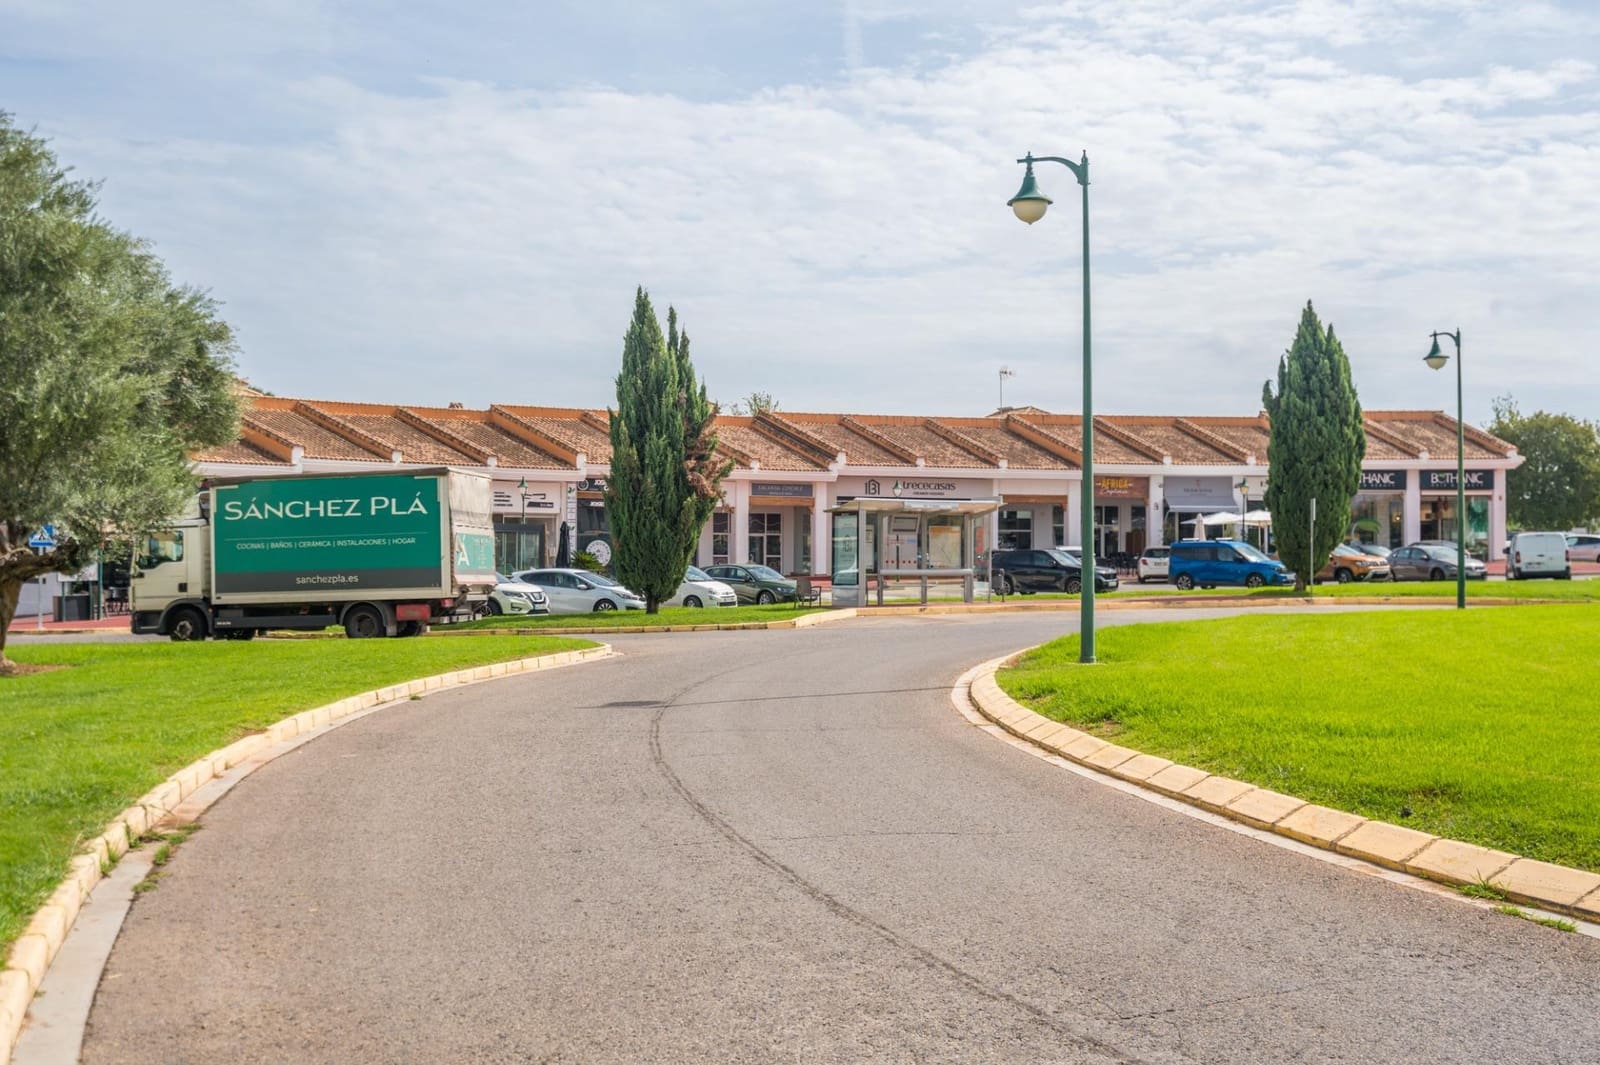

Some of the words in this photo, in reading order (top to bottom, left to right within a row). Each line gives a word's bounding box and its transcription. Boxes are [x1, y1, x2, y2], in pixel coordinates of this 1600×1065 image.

[1101, 478, 1129, 489] AFRICA
[1430, 472, 1484, 484] BOTHNIC
[902, 480, 957, 491] trececasas
[224, 497, 362, 520] SÁNCHEZ
[370, 491, 428, 516] PLÁ
[236, 543, 265, 551] COCINAS
[270, 541, 293, 549] BAÑOS
[298, 540, 331, 548] CERÁMICA
[336, 538, 387, 547] INSTALACIONES
[392, 537, 416, 545] HOGAR
[295, 574, 359, 585] sanchezpla.es
